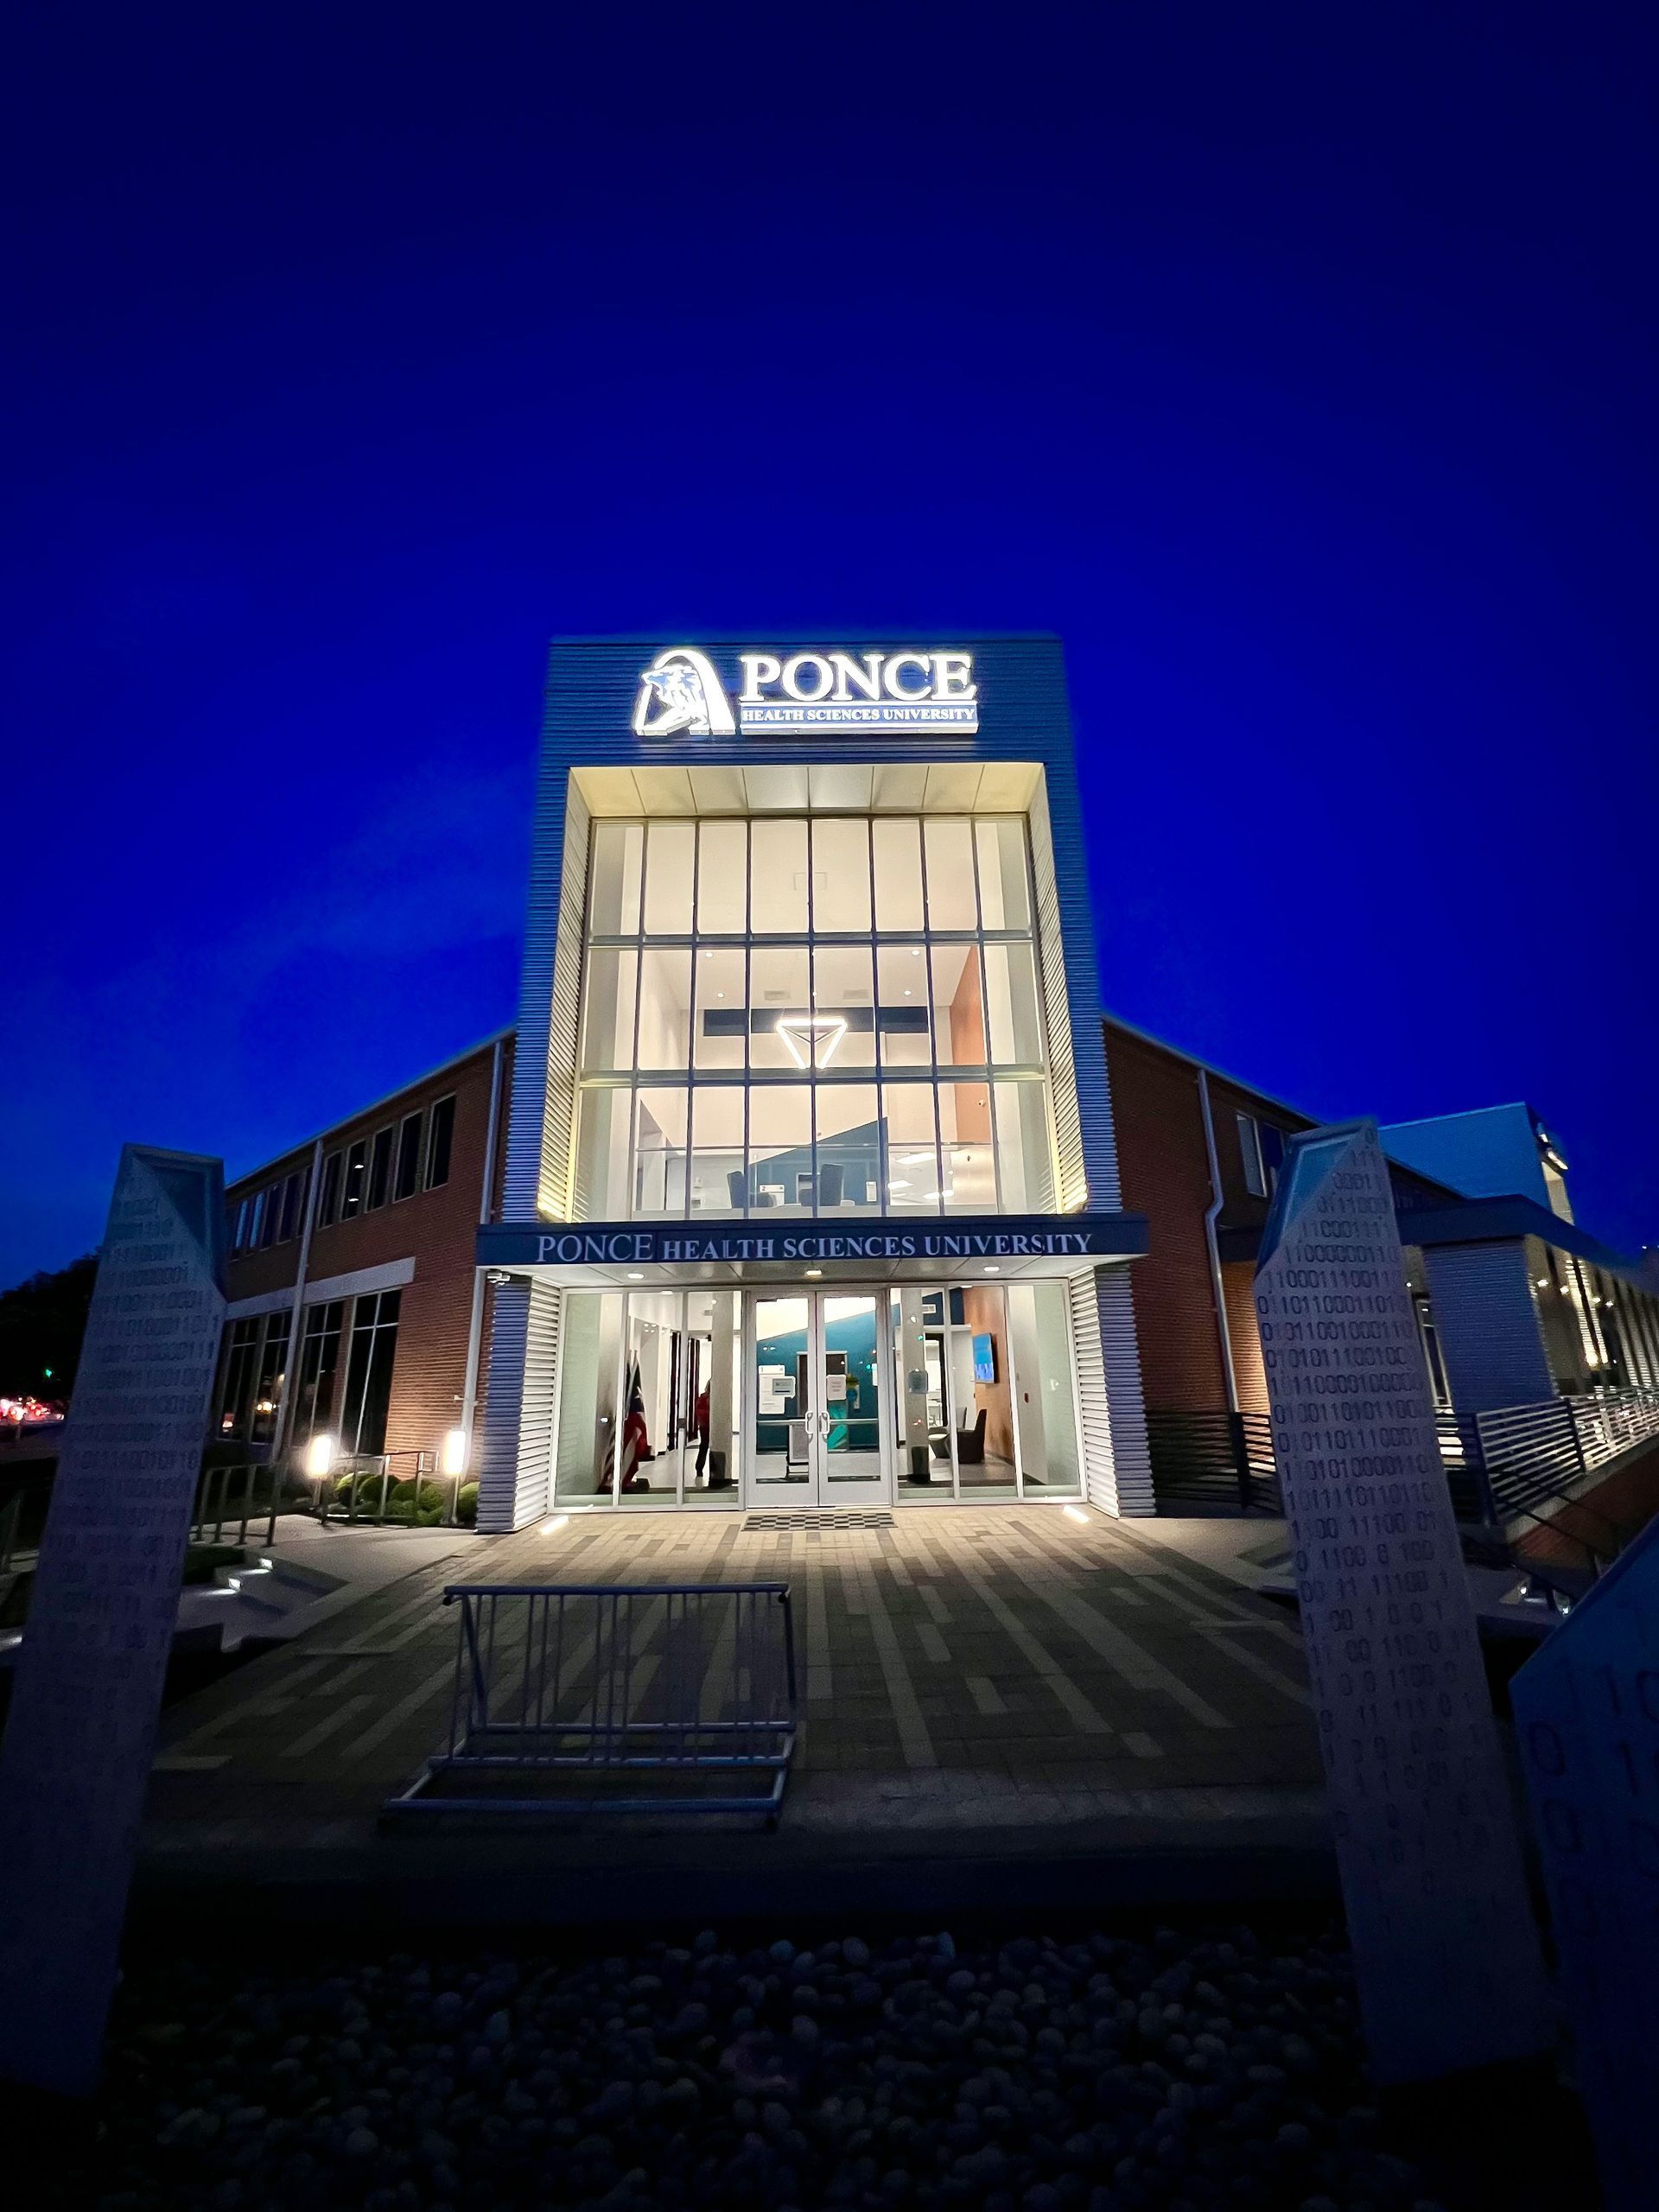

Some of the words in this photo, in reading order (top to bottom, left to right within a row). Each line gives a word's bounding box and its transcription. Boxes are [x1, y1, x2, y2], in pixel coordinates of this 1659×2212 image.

[740, 652, 977, 702] PONCE
[741, 709, 804, 721] HEALTH
[807, 709, 880, 721] SCIENCES
[883, 708, 976, 721] UNIVERSITY
[536, 1234, 653, 1262] PONCE
[663, 1239, 774, 1260] HEALTH
[783, 1236, 915, 1258] SCIENCES
[925, 1234, 1093, 1255] UNIVERSITY
